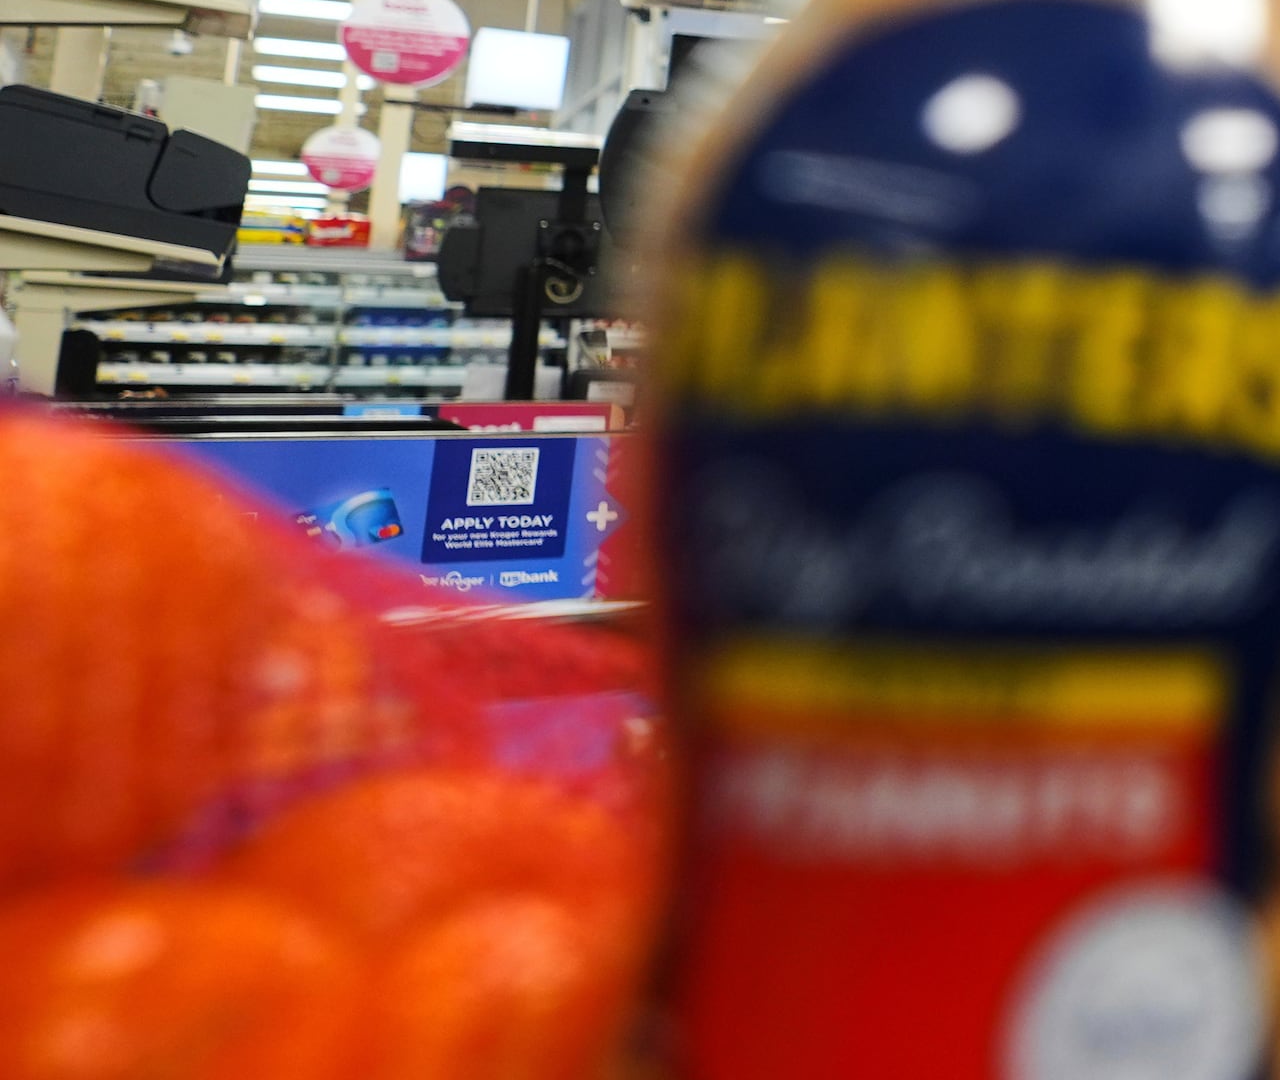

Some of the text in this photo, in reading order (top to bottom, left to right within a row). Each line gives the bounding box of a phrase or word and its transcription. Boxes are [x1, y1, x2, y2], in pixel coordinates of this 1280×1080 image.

[441, 514, 553, 531] APPLY TODAY
[448, 532, 468, 542] your
[490, 530, 520, 540] Kroger
[521, 528, 558, 538] Rewards
[445, 540, 472, 550] World
[440, 570, 485, 592] Kroger
